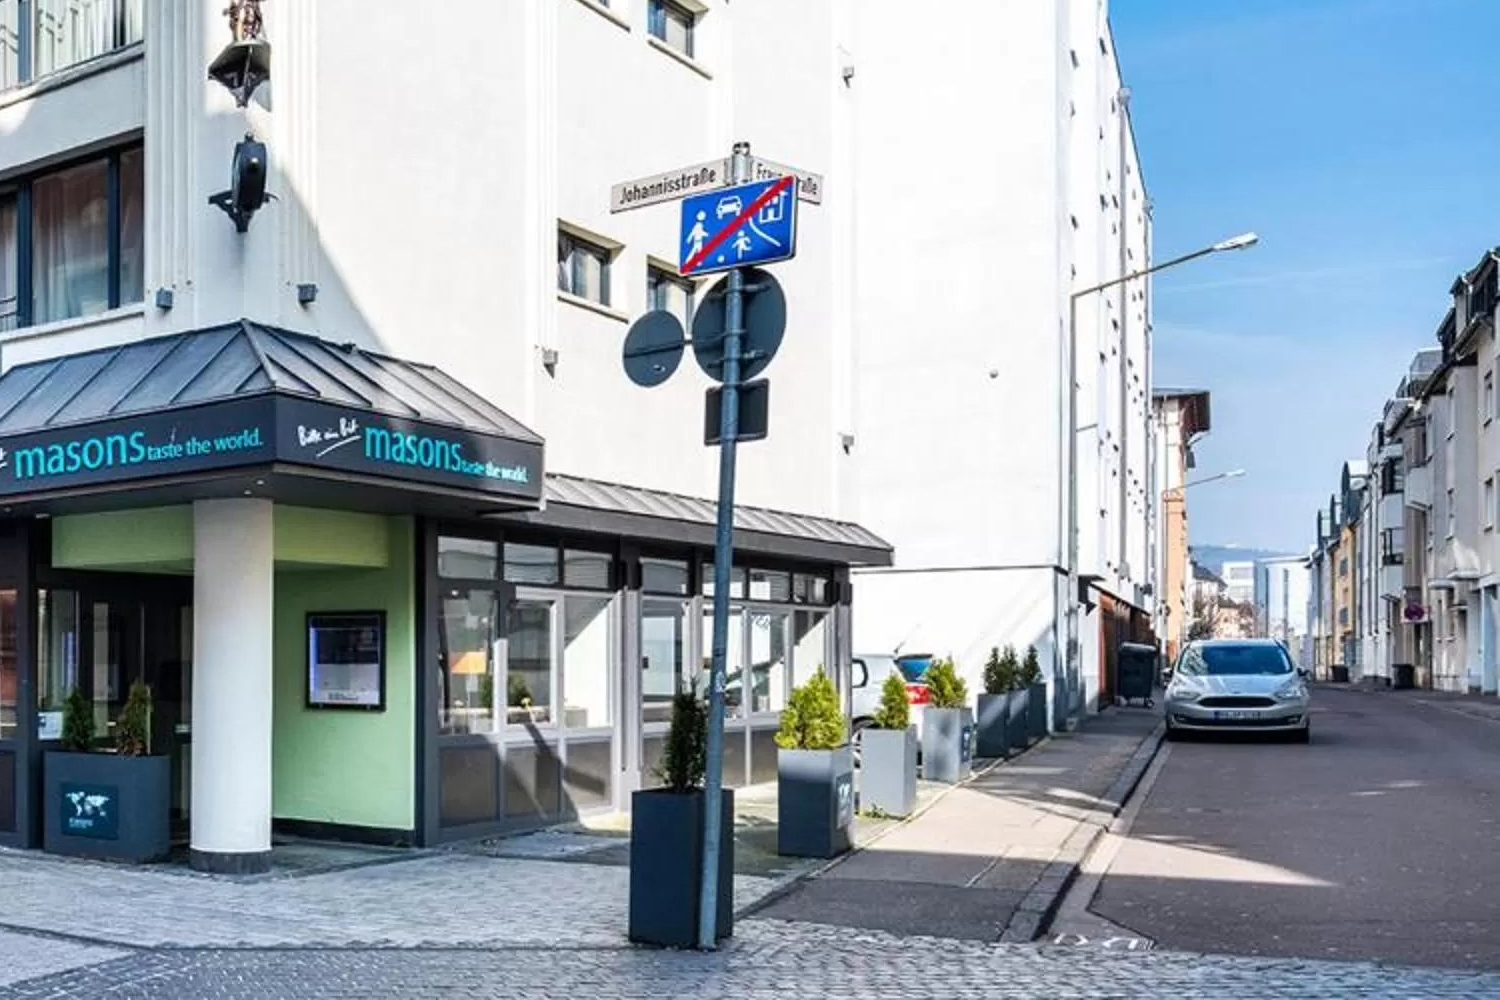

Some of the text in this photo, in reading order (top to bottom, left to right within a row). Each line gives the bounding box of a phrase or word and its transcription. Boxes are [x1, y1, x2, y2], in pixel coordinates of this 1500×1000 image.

[620, 167, 716, 204] Johannisstraße
[14, 427, 264, 478] masons taste the world.
[364, 426, 462, 471] masons
